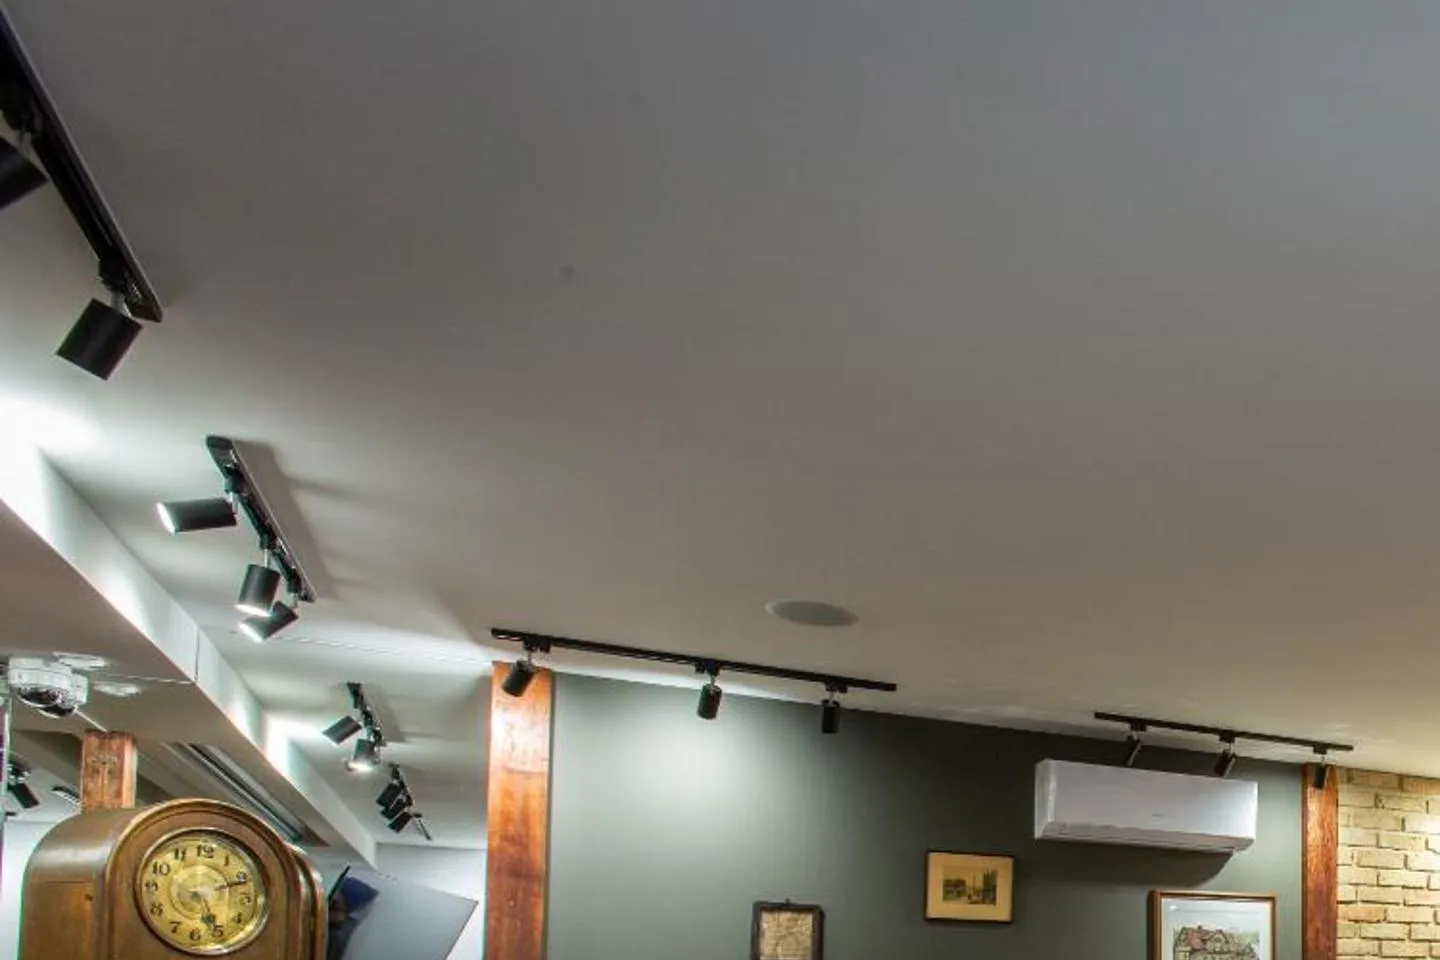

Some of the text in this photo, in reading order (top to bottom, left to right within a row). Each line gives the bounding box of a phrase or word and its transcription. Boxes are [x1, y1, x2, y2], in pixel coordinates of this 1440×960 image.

[174, 848, 186, 861] 11
[197, 844, 214, 858] 12
[224, 854, 230, 866] 1
[152, 861, 171, 876] 10
[150, 902, 163, 916] 8
[232, 912, 242, 924] 4
[169, 921, 182, 934] 7
[212, 925, 224, 938] 5
[190, 928, 201, 941] 6
